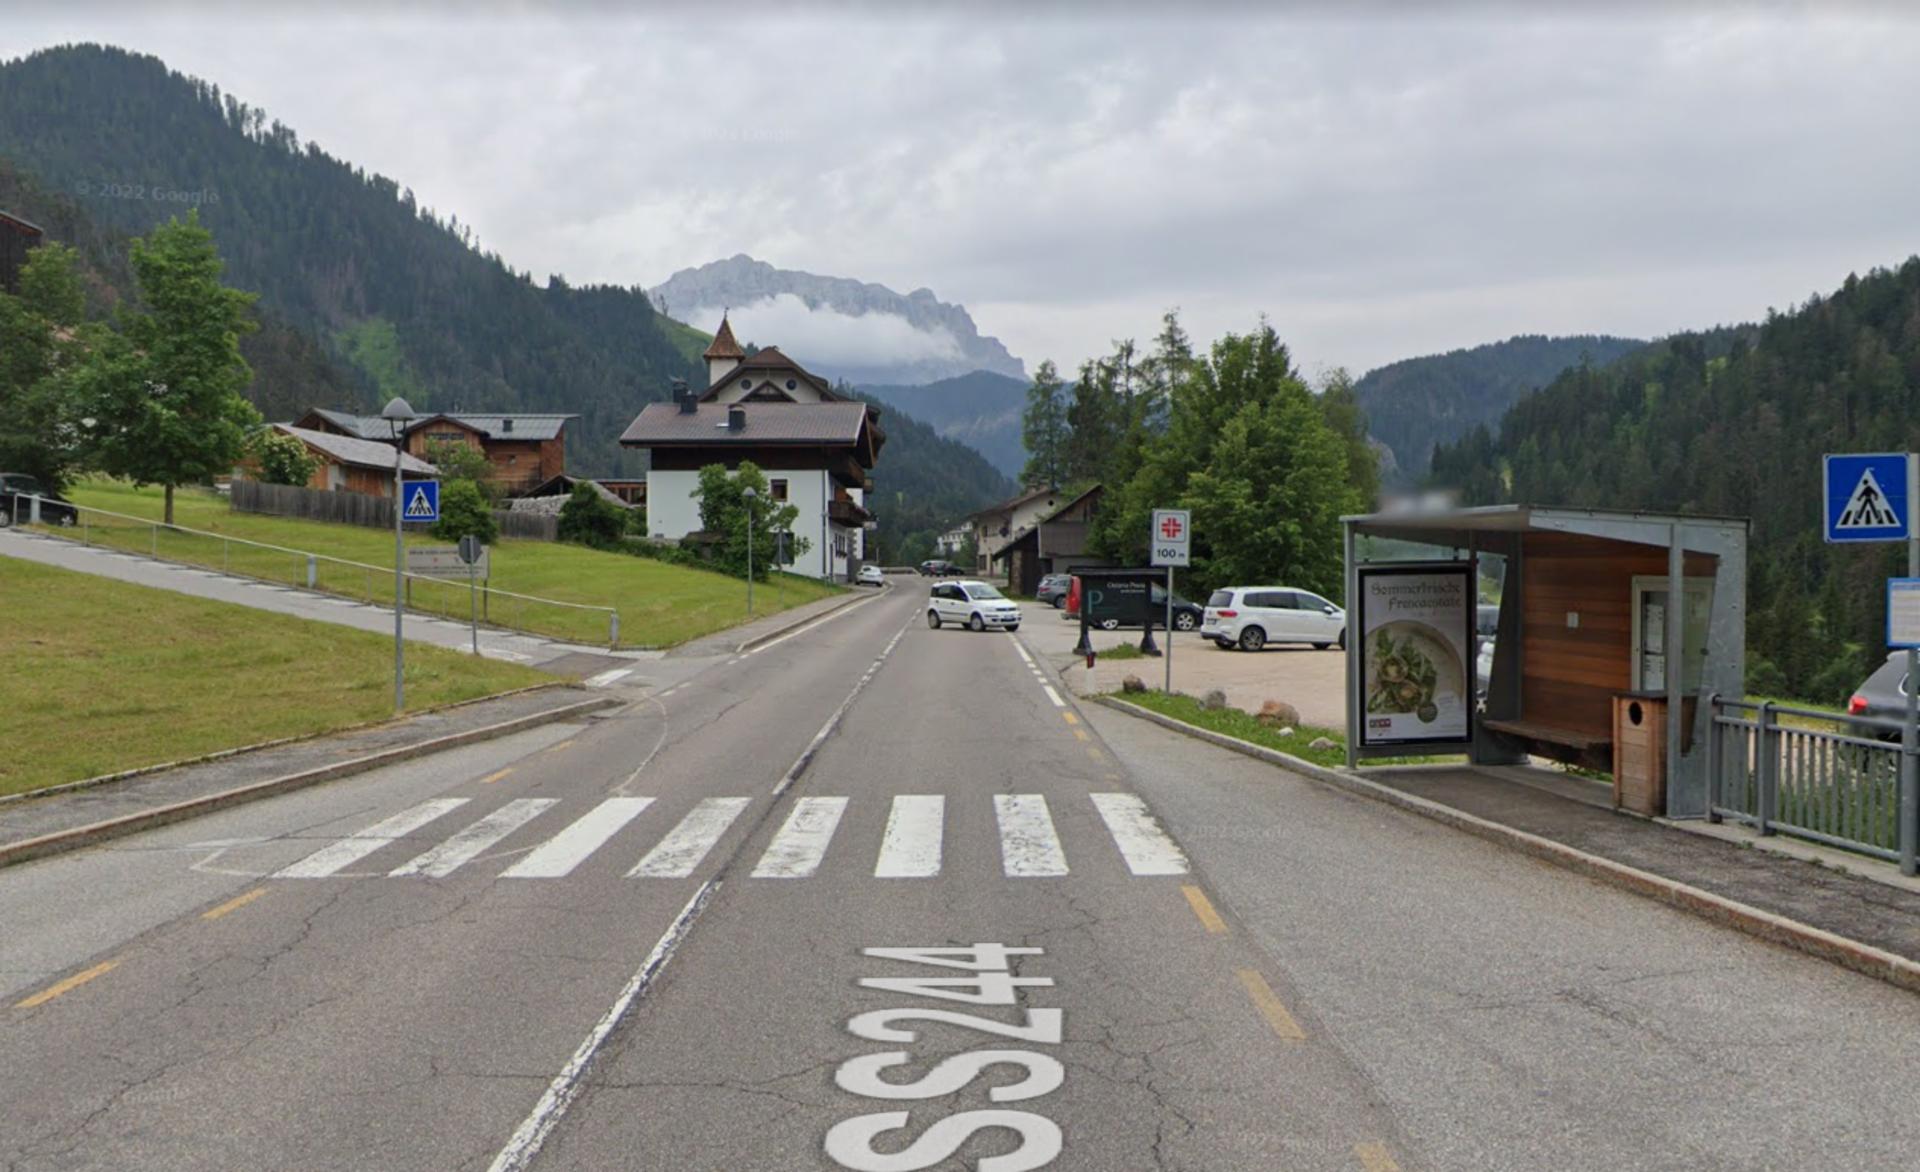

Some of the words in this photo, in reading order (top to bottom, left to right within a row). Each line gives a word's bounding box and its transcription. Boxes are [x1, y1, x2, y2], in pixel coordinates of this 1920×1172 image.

[1156, 548, 1177, 559] 100
[1087, 590, 1103, 614] P
[824, 943, 1065, 1172] SS244
